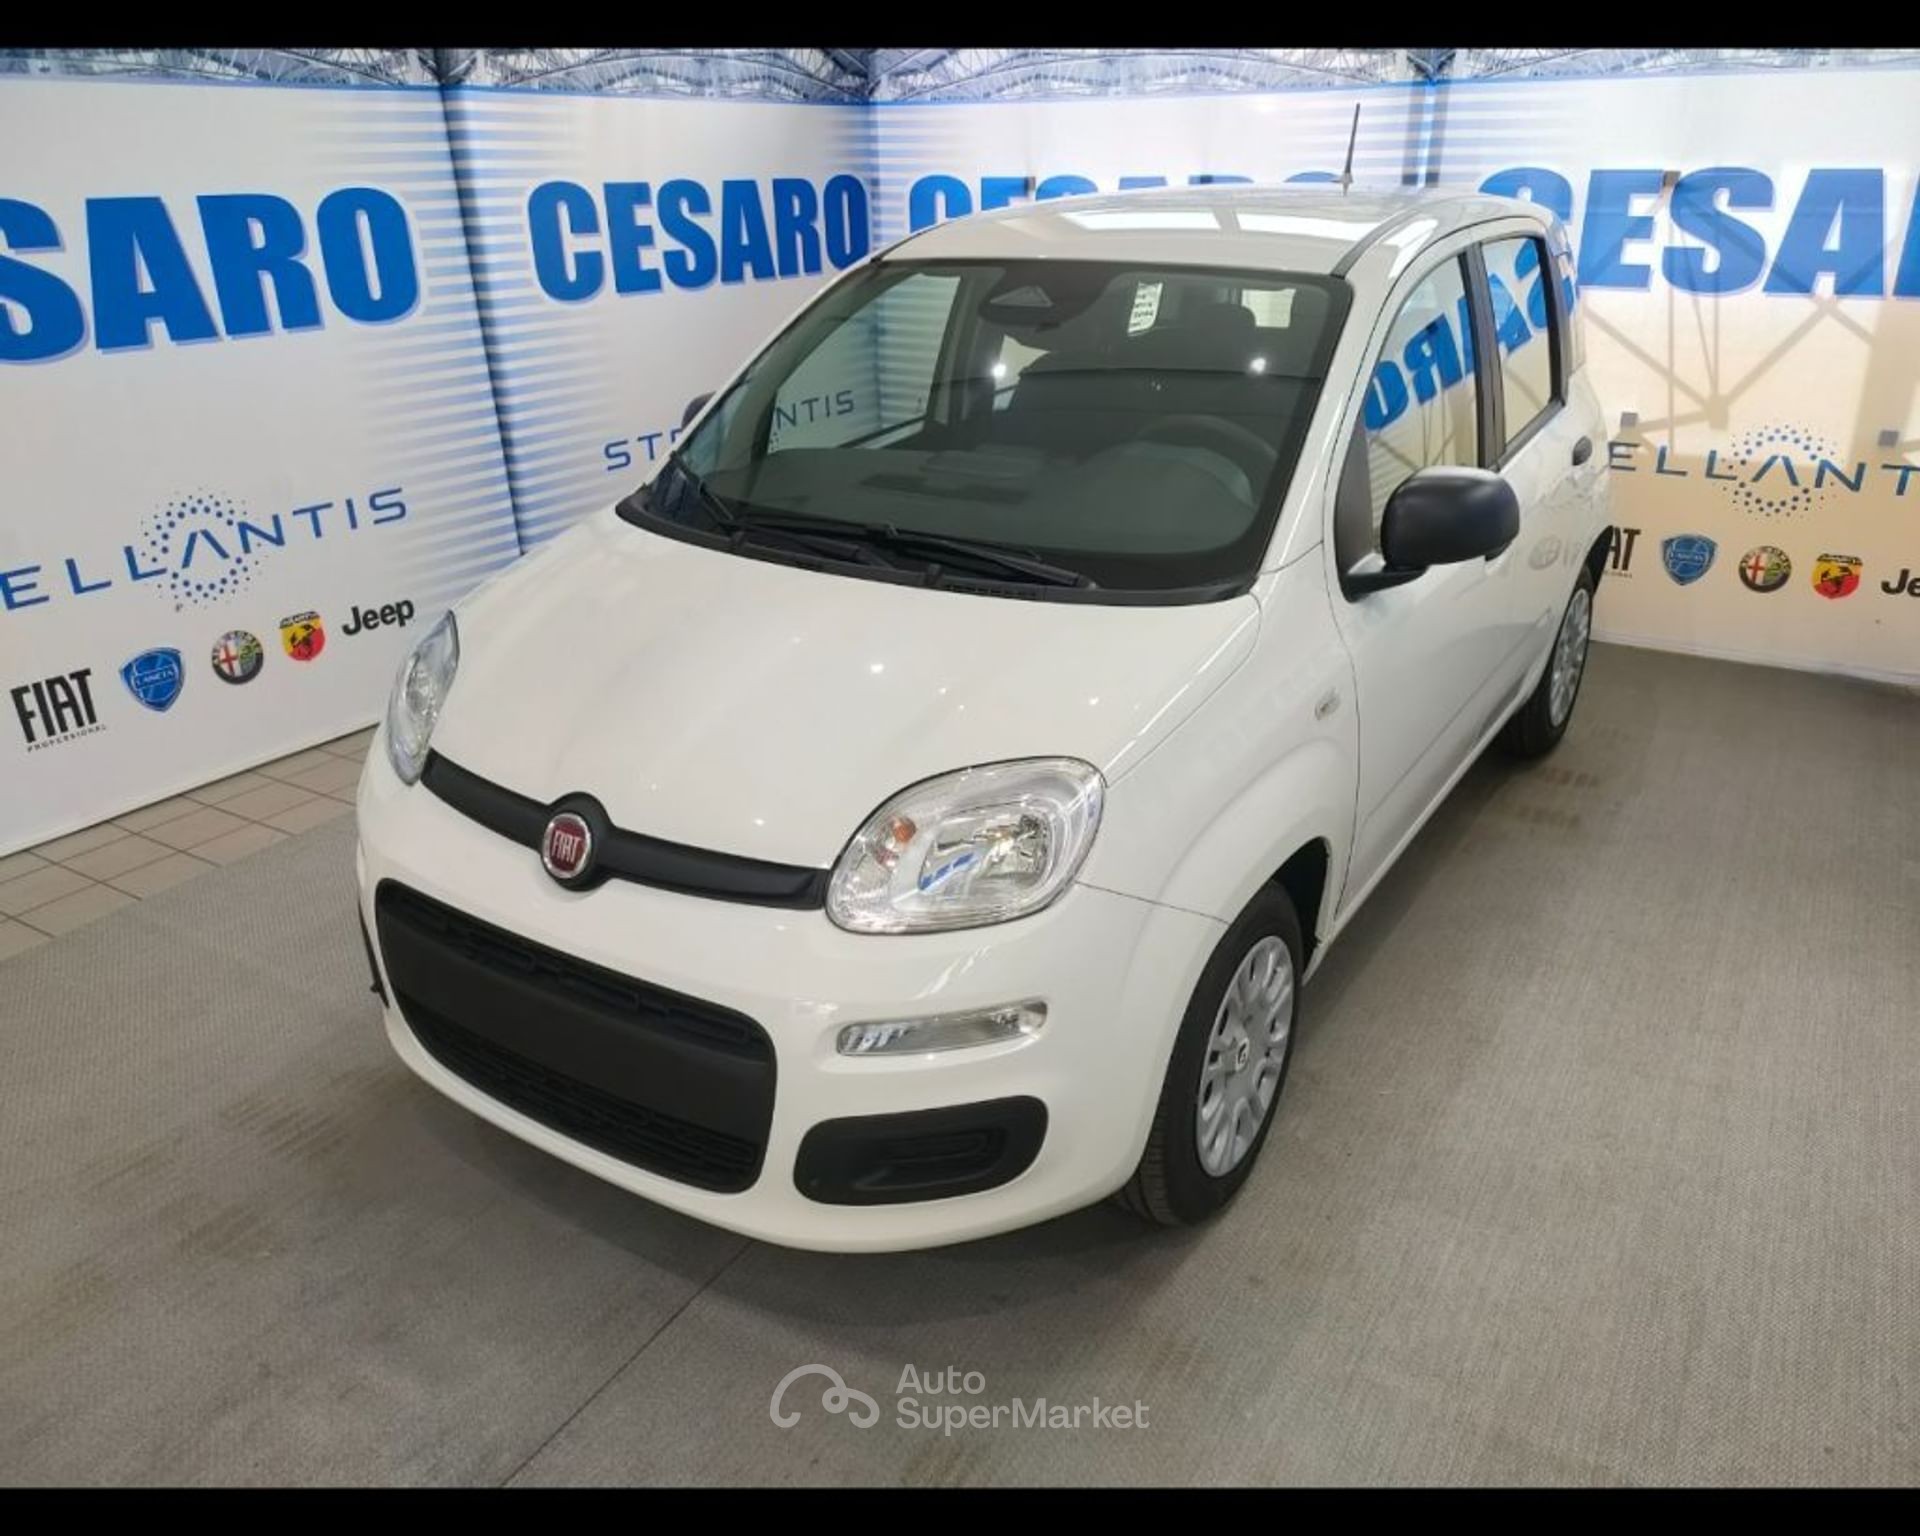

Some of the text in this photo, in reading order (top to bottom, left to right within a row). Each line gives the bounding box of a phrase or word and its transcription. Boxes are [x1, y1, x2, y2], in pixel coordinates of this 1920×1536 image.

[528, 173, 869, 303] CESARO
[1477, 166, 1920, 299] ESA
[342, 599, 415, 636] Jeep
[10, 668, 97, 743] FIAT
[551, 829, 581, 863] FIAT
